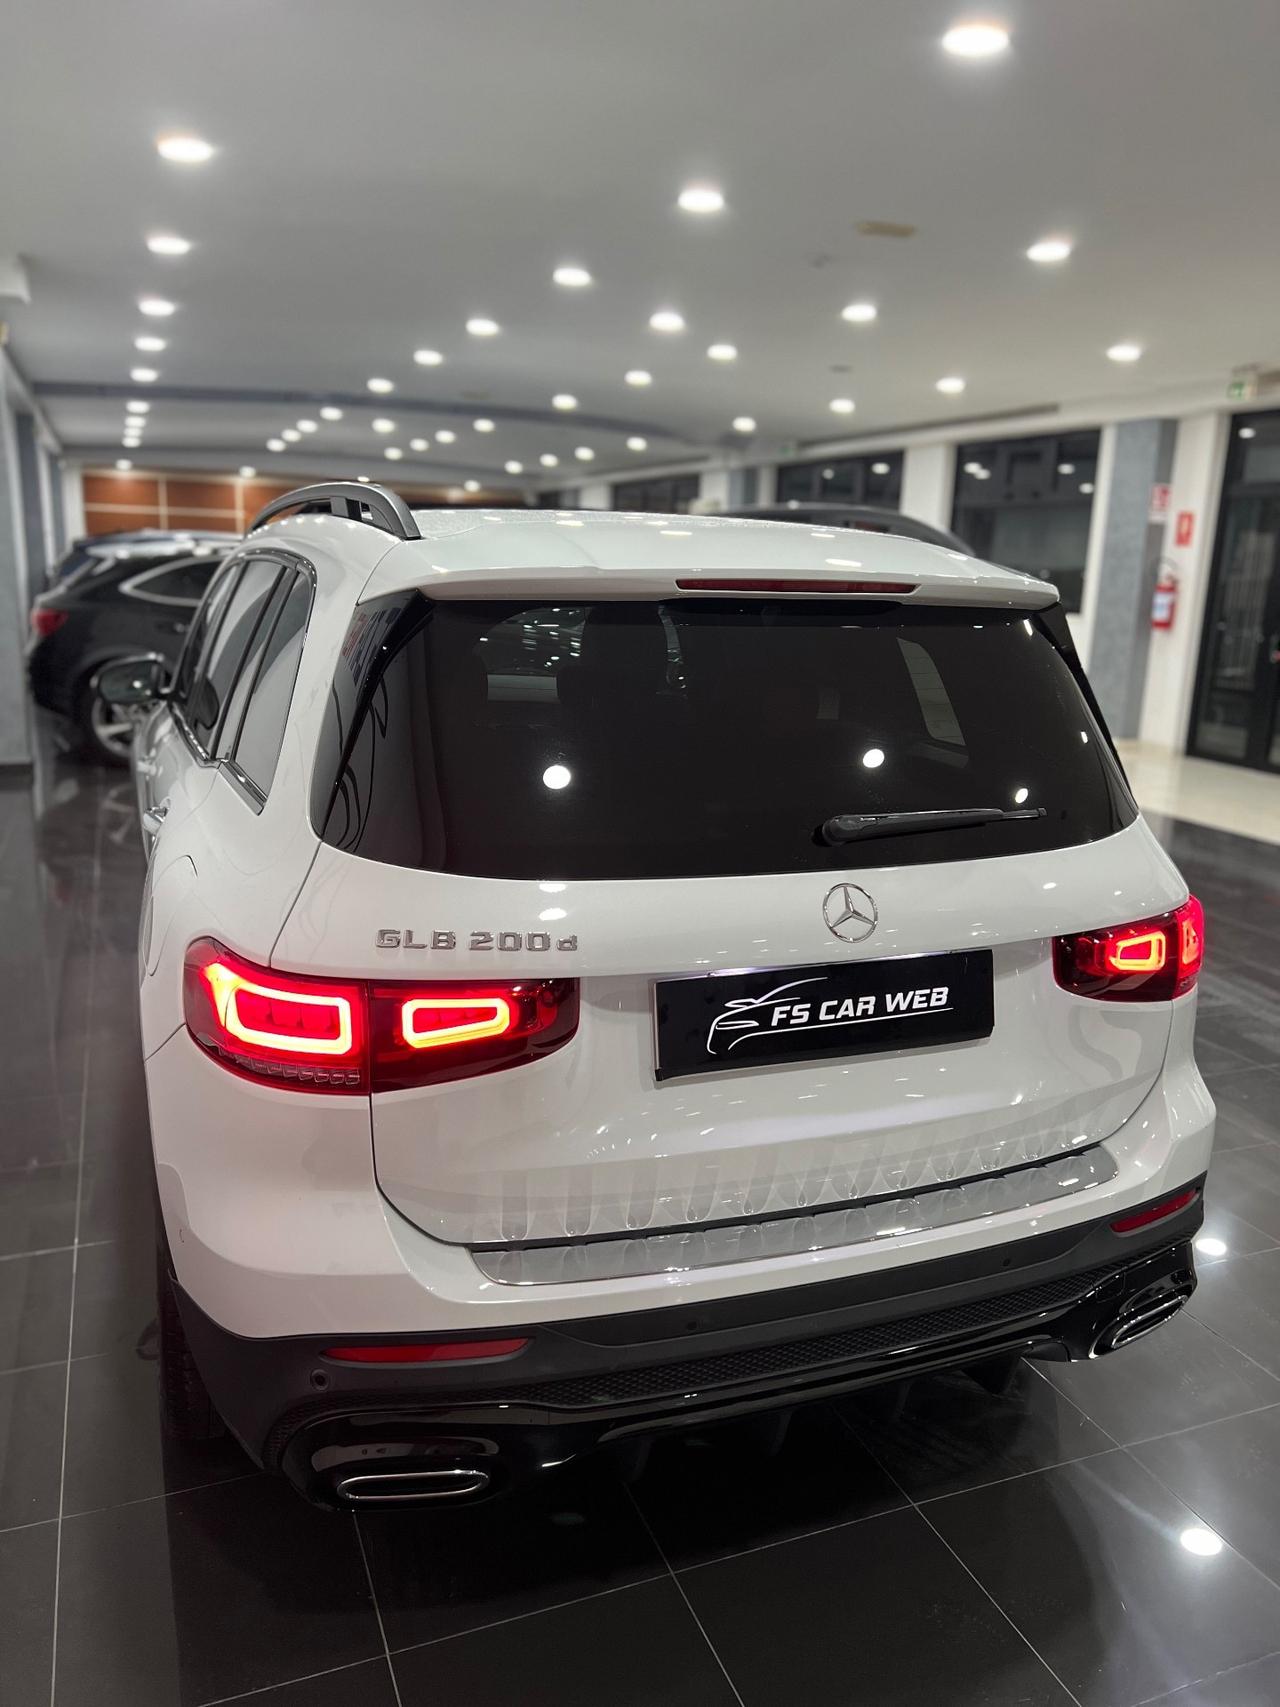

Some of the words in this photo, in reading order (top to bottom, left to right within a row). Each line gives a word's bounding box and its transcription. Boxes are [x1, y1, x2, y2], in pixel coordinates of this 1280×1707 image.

[376, 929, 456, 950] GLB
[771, 1003, 811, 1027] FS
[819, 996, 875, 1021] CAR
[884, 986, 949, 1013] WEB
